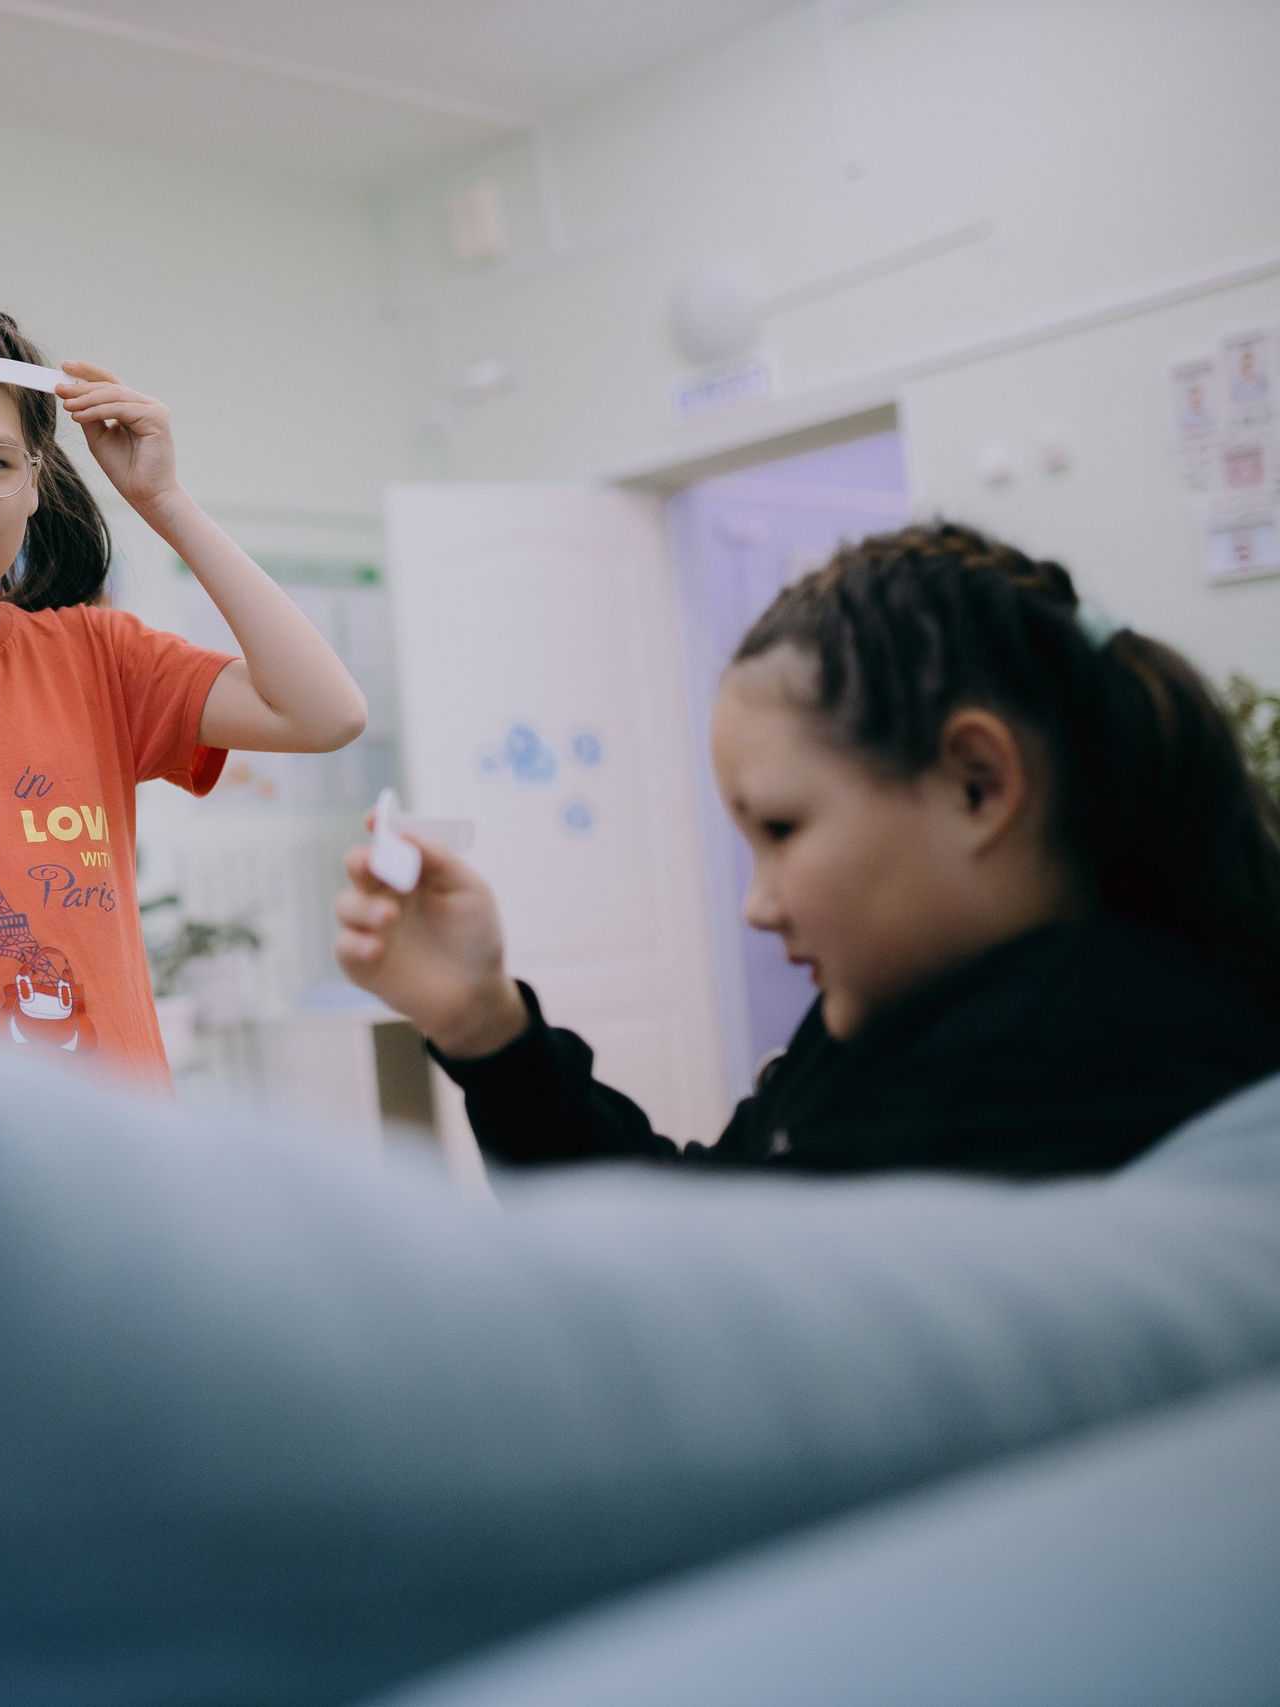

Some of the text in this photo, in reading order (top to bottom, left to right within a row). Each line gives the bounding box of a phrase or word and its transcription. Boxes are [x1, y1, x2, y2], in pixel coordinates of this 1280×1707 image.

[14, 766, 54, 799] in
[20, 805, 110, 843] LOV
[27, 863, 116, 913] Paris
